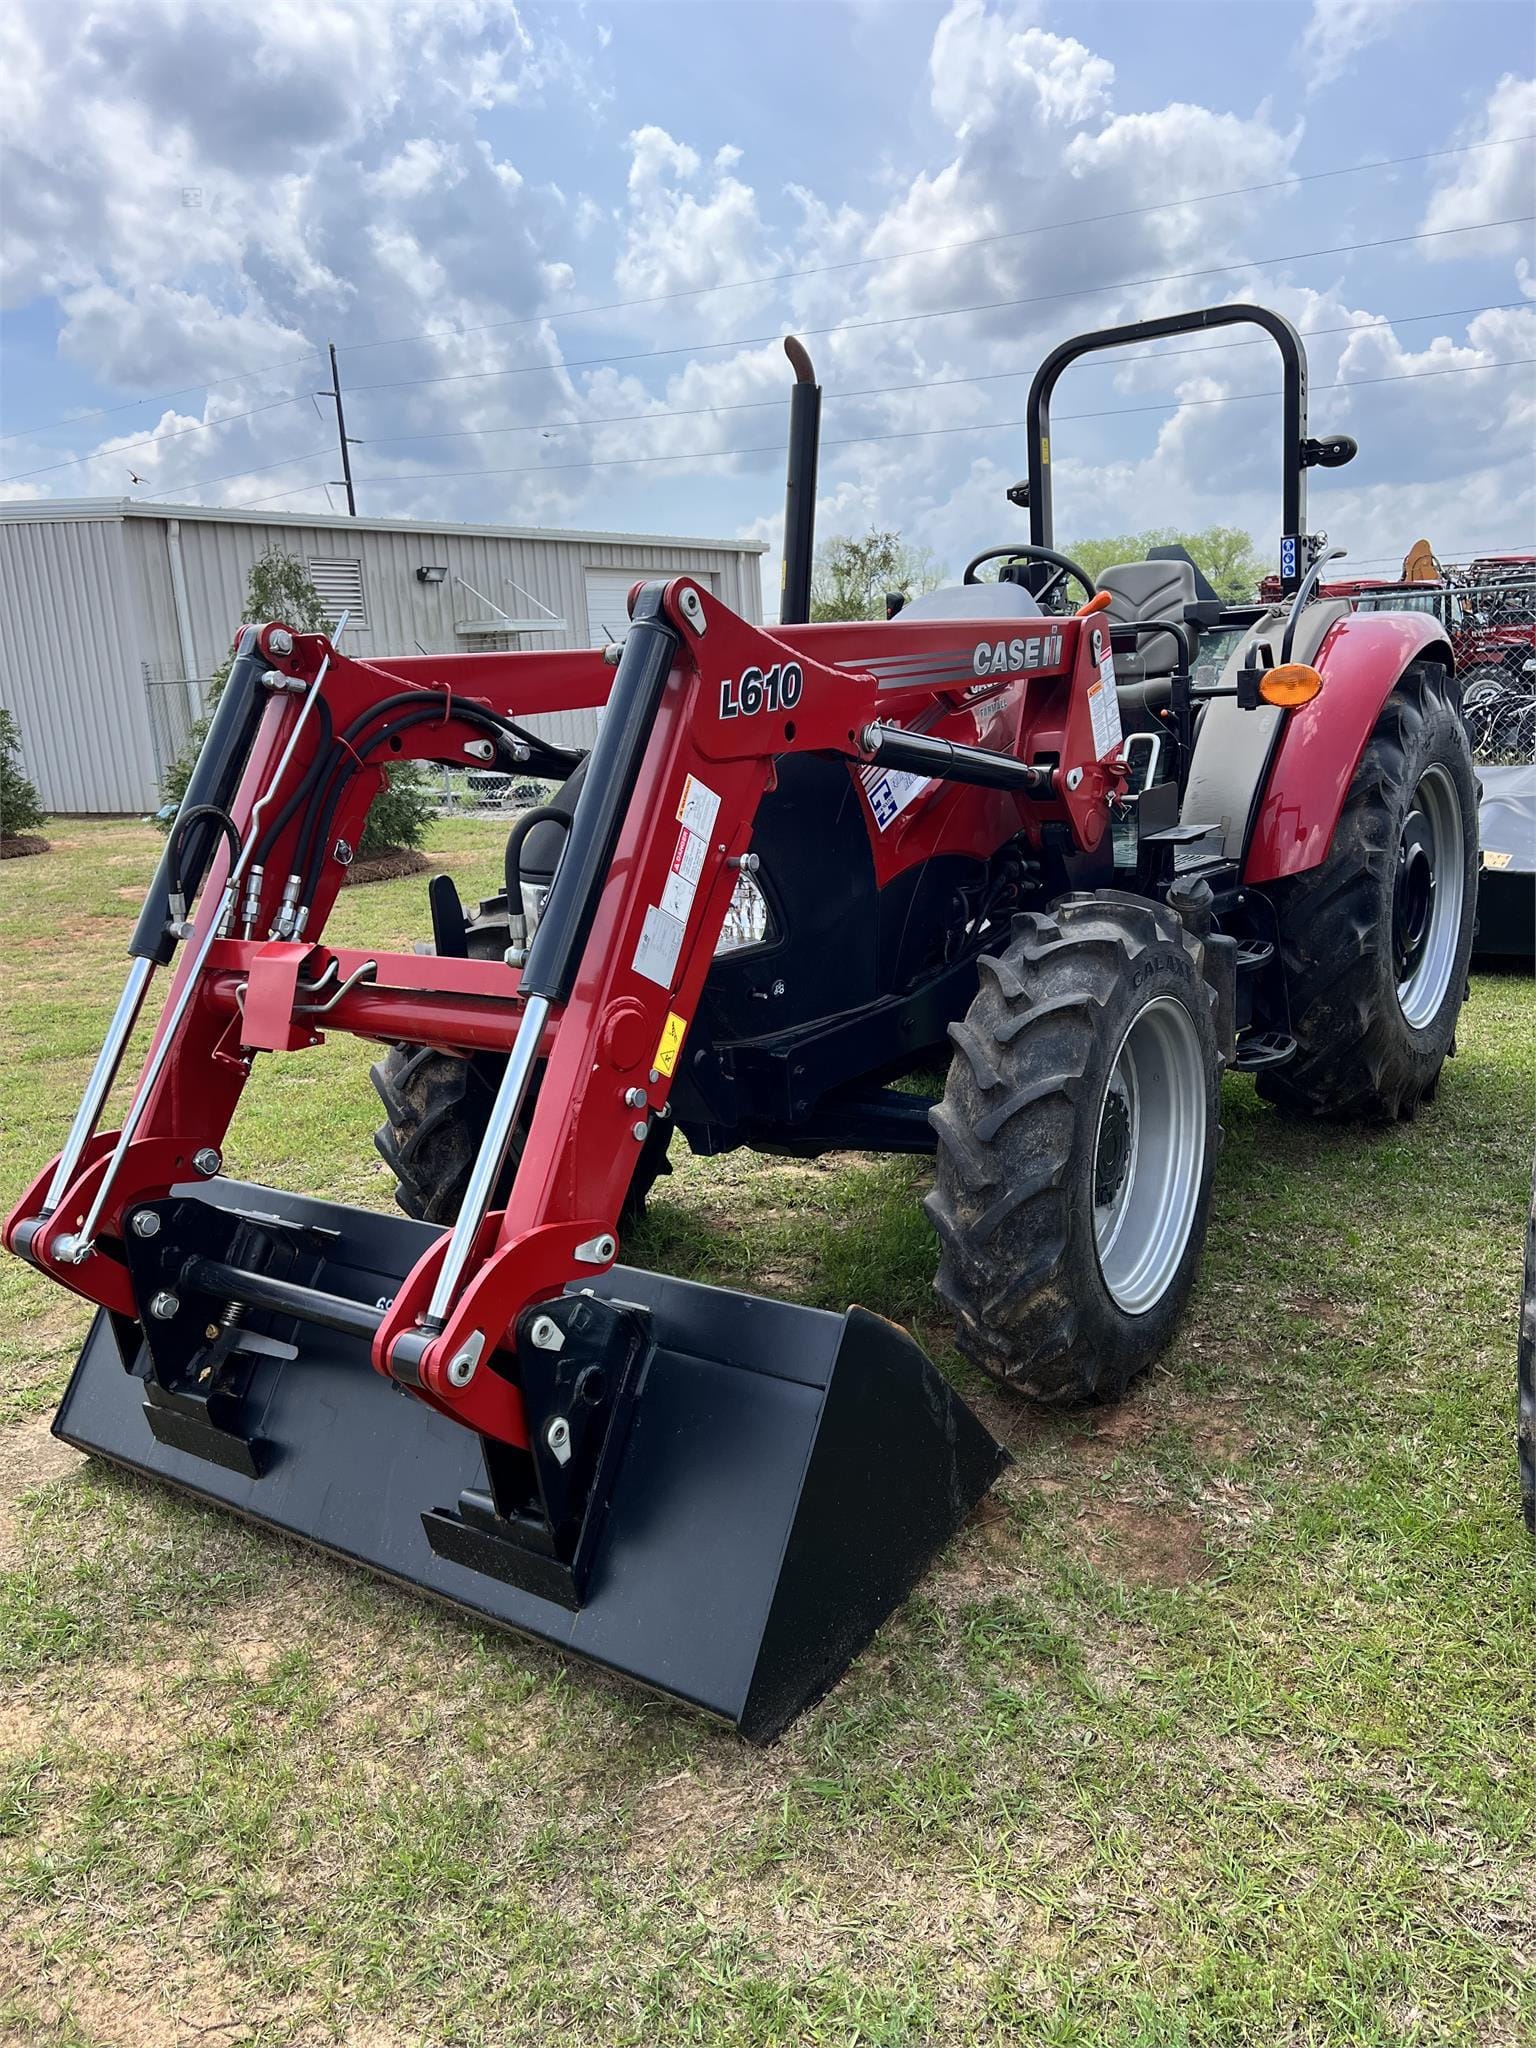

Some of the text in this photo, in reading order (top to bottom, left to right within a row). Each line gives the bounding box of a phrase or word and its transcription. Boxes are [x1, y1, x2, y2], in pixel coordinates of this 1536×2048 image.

[973, 638, 1040, 675] CASE
[719, 661, 803, 719] L610
[676, 831, 689, 862] DANGER
